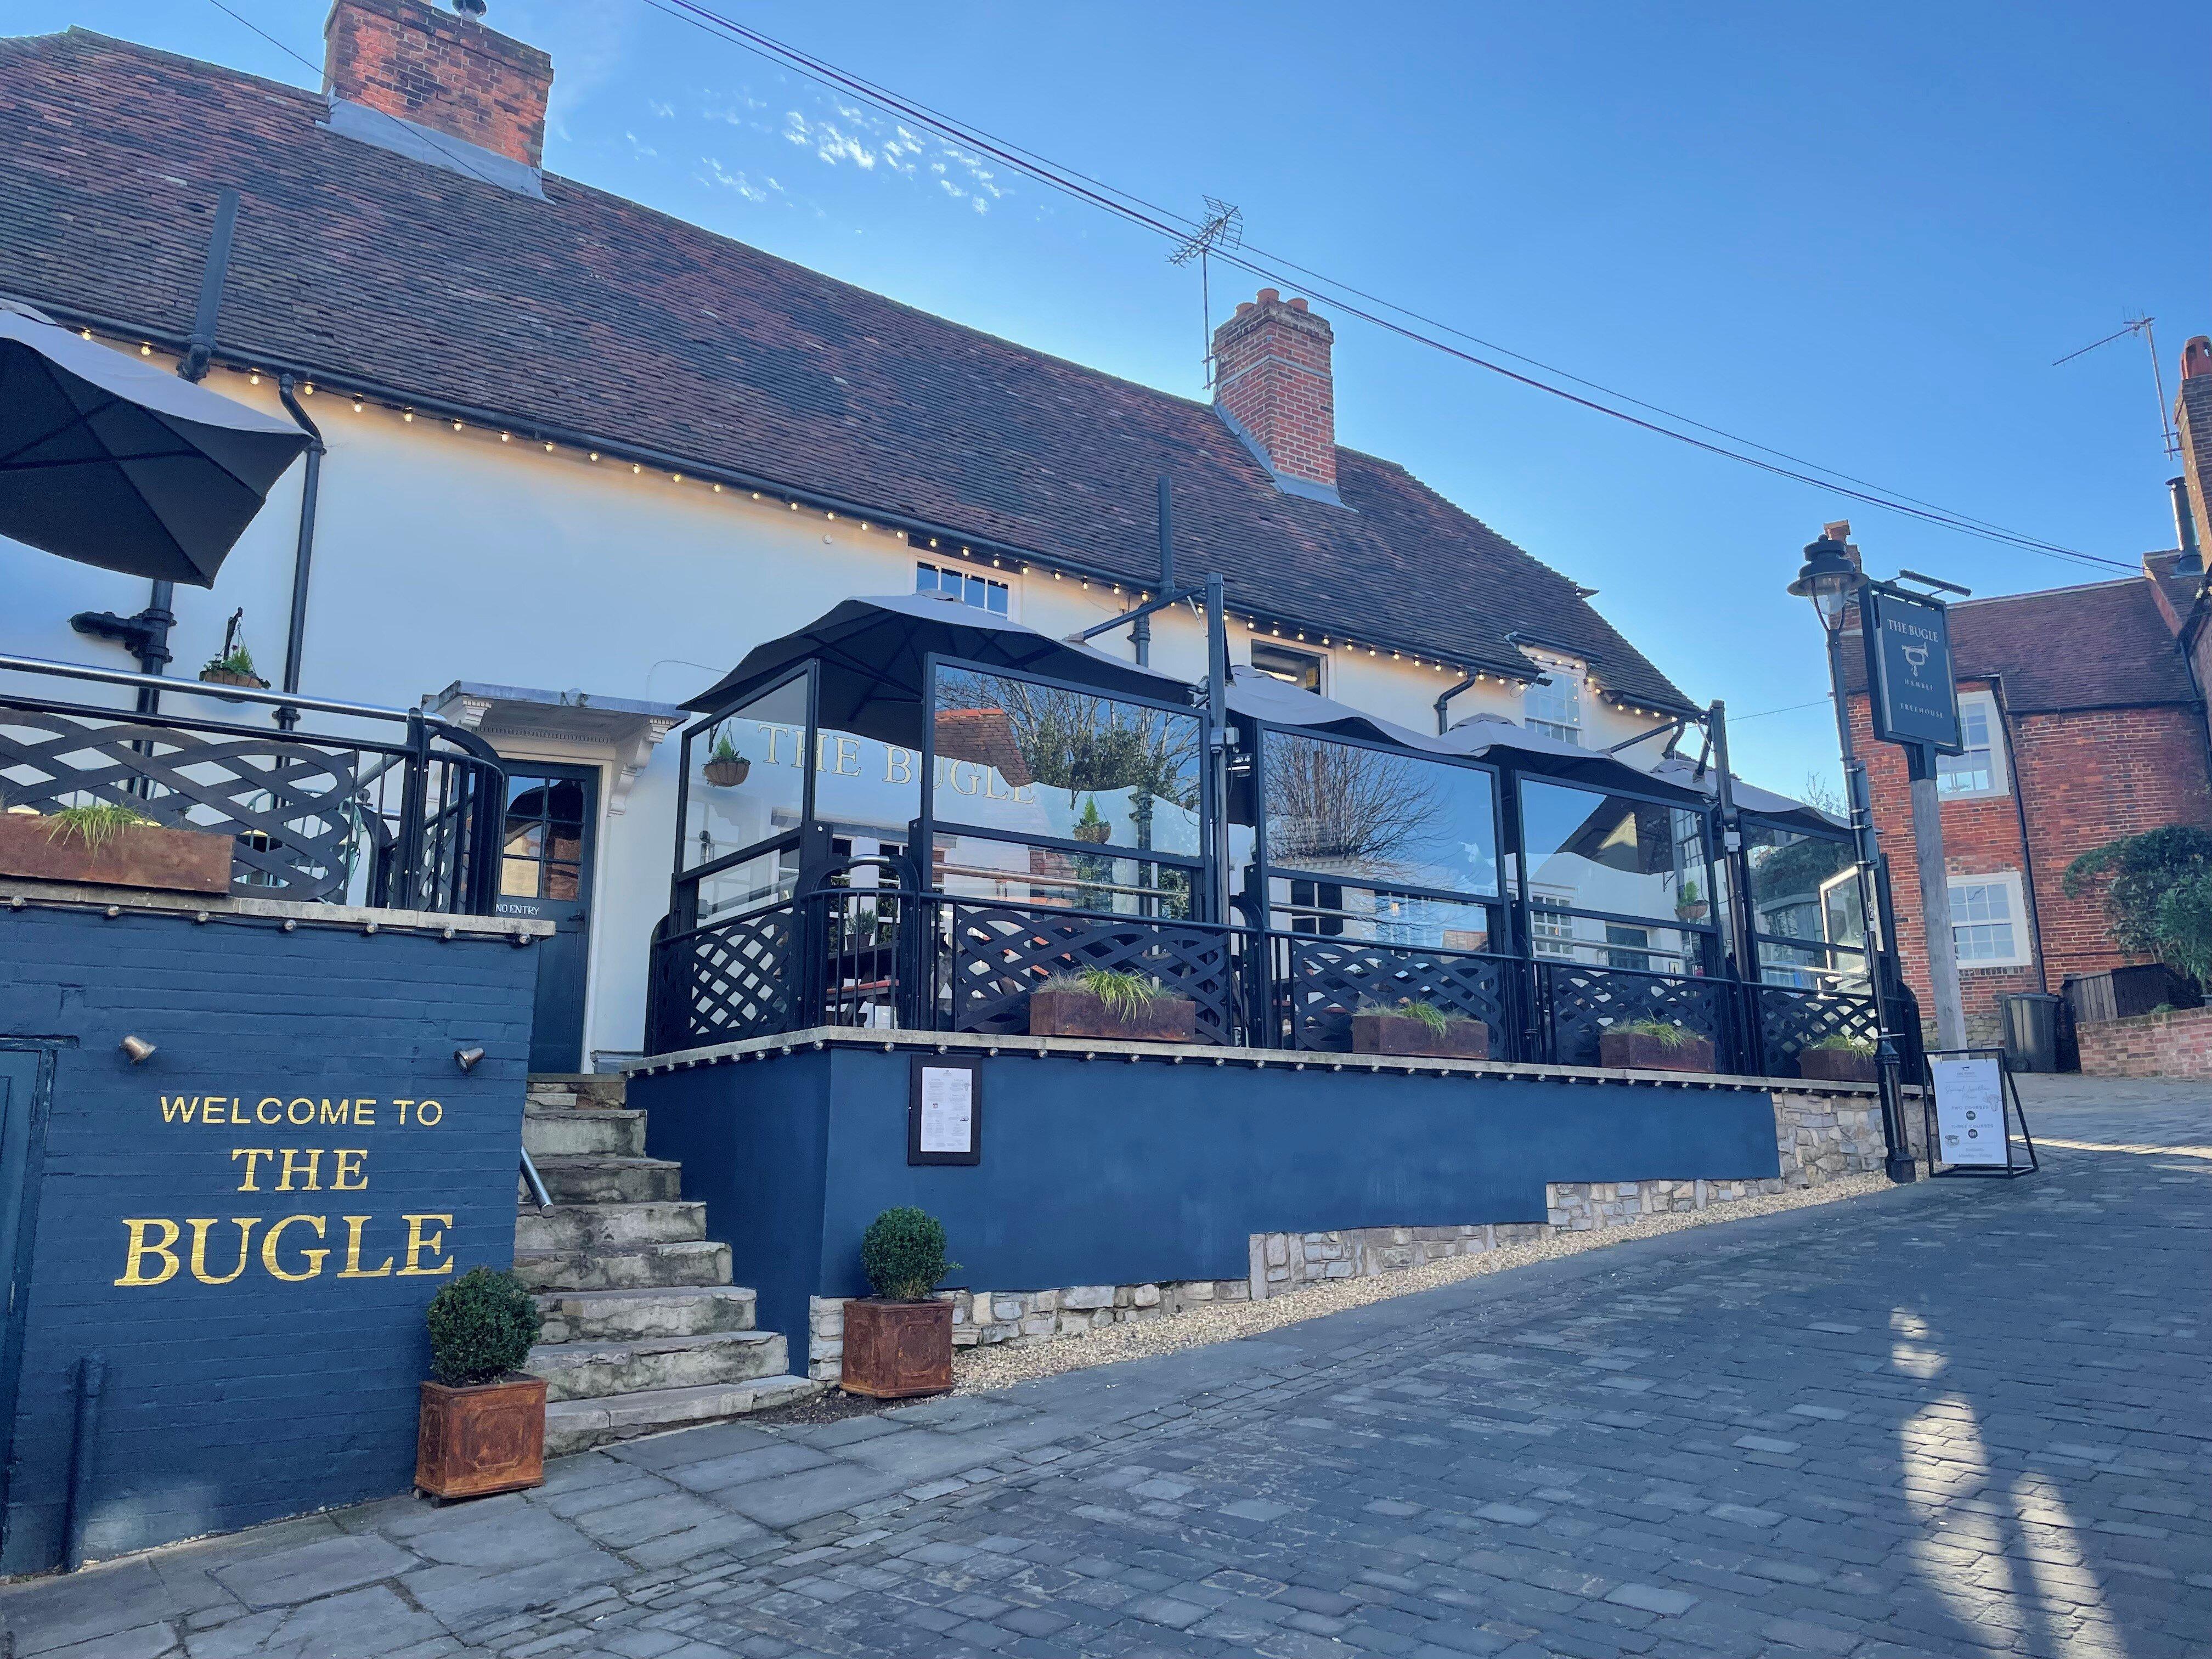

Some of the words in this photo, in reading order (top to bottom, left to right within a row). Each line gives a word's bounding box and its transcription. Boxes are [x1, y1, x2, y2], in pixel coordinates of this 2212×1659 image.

[1887, 619, 1907, 634] THE
[1909, 624, 1938, 642] BUGLE
[1904, 679, 1933, 691] HAMBLE
[1900, 703, 1944, 719] FREEHOUSE
[758, 723, 862, 777] THE
[496, 903, 507, 913] NO
[510, 905, 539, 915] ENTRY
[161, 1096, 376, 1126] WELCOME
[393, 1099, 443, 1126] TO
[232, 1148, 369, 1192] THE
[114, 1214, 454, 1287] BUGLE
